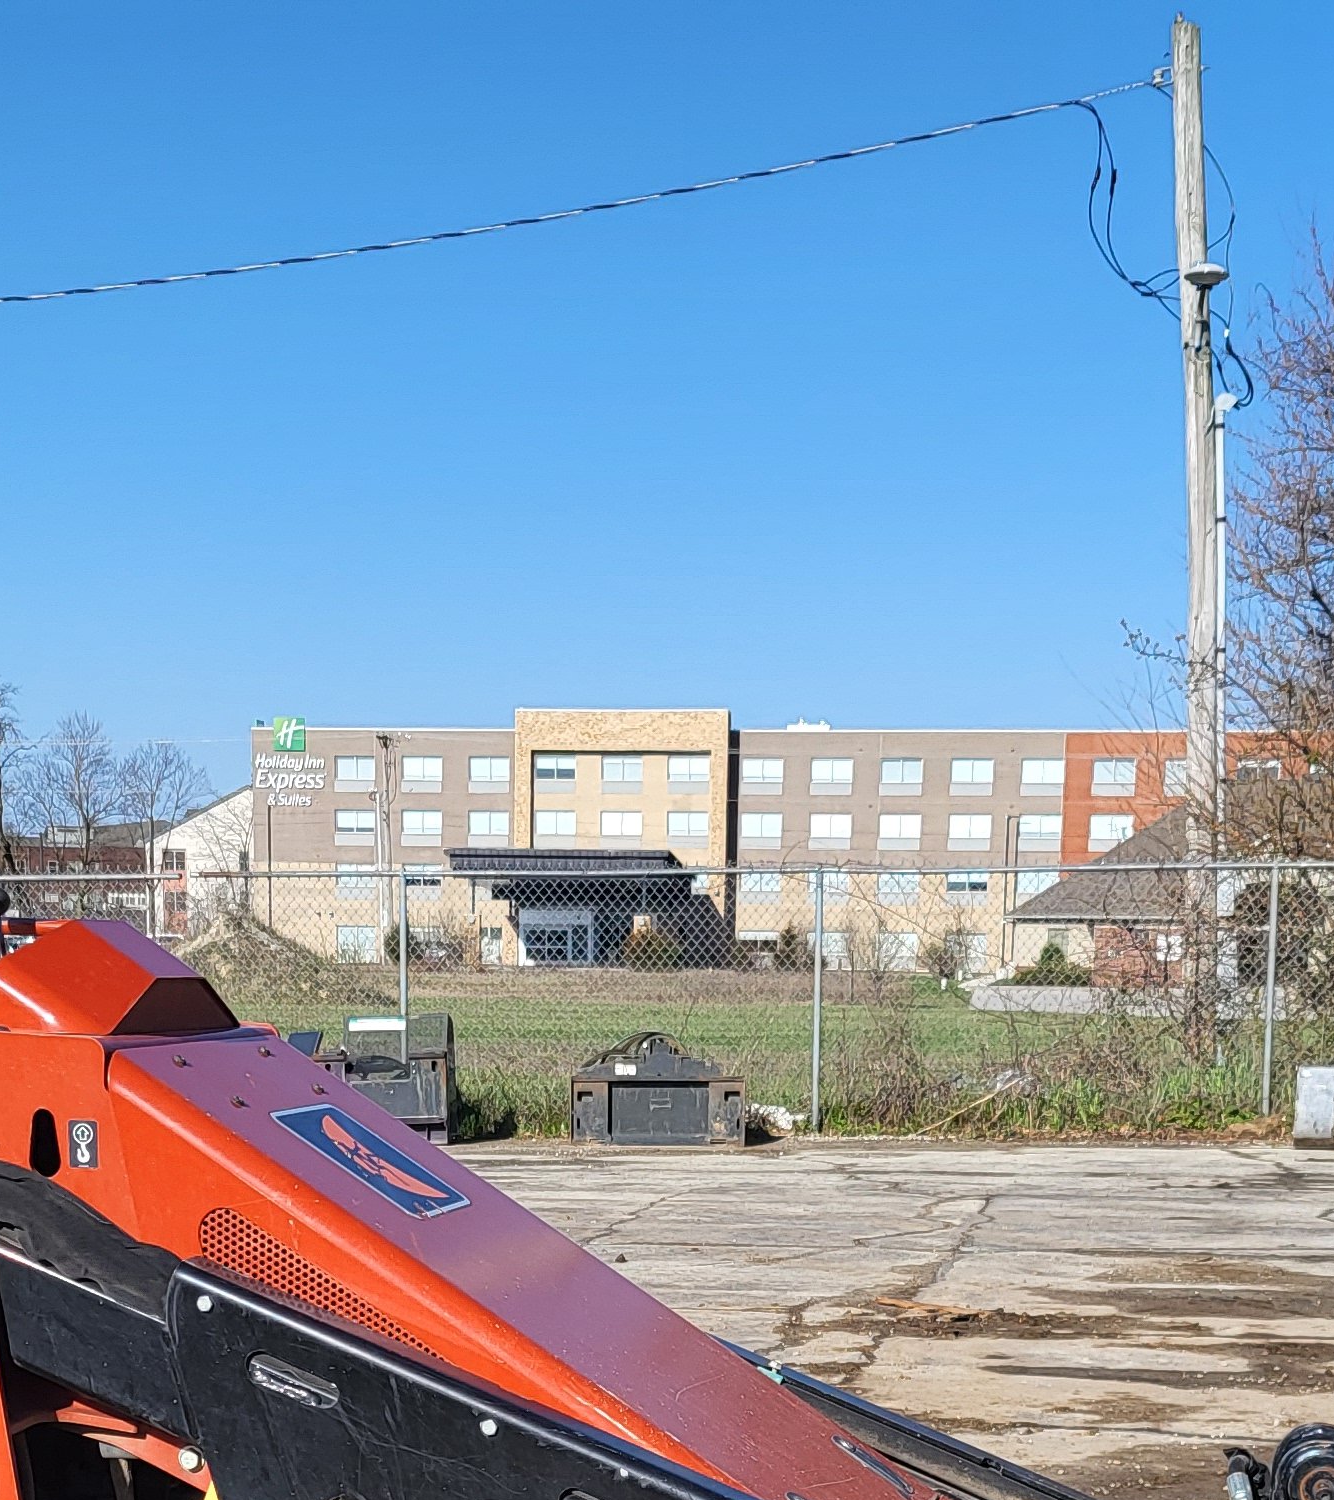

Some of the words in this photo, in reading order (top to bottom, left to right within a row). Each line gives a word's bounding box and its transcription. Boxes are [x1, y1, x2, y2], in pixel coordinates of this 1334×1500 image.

[254, 752, 304, 772] Holiday
[304, 753, 325, 769] Inn
[255, 768, 326, 794] Express
[267, 793, 276, 806] &
[277, 793, 313, 807] Suites
